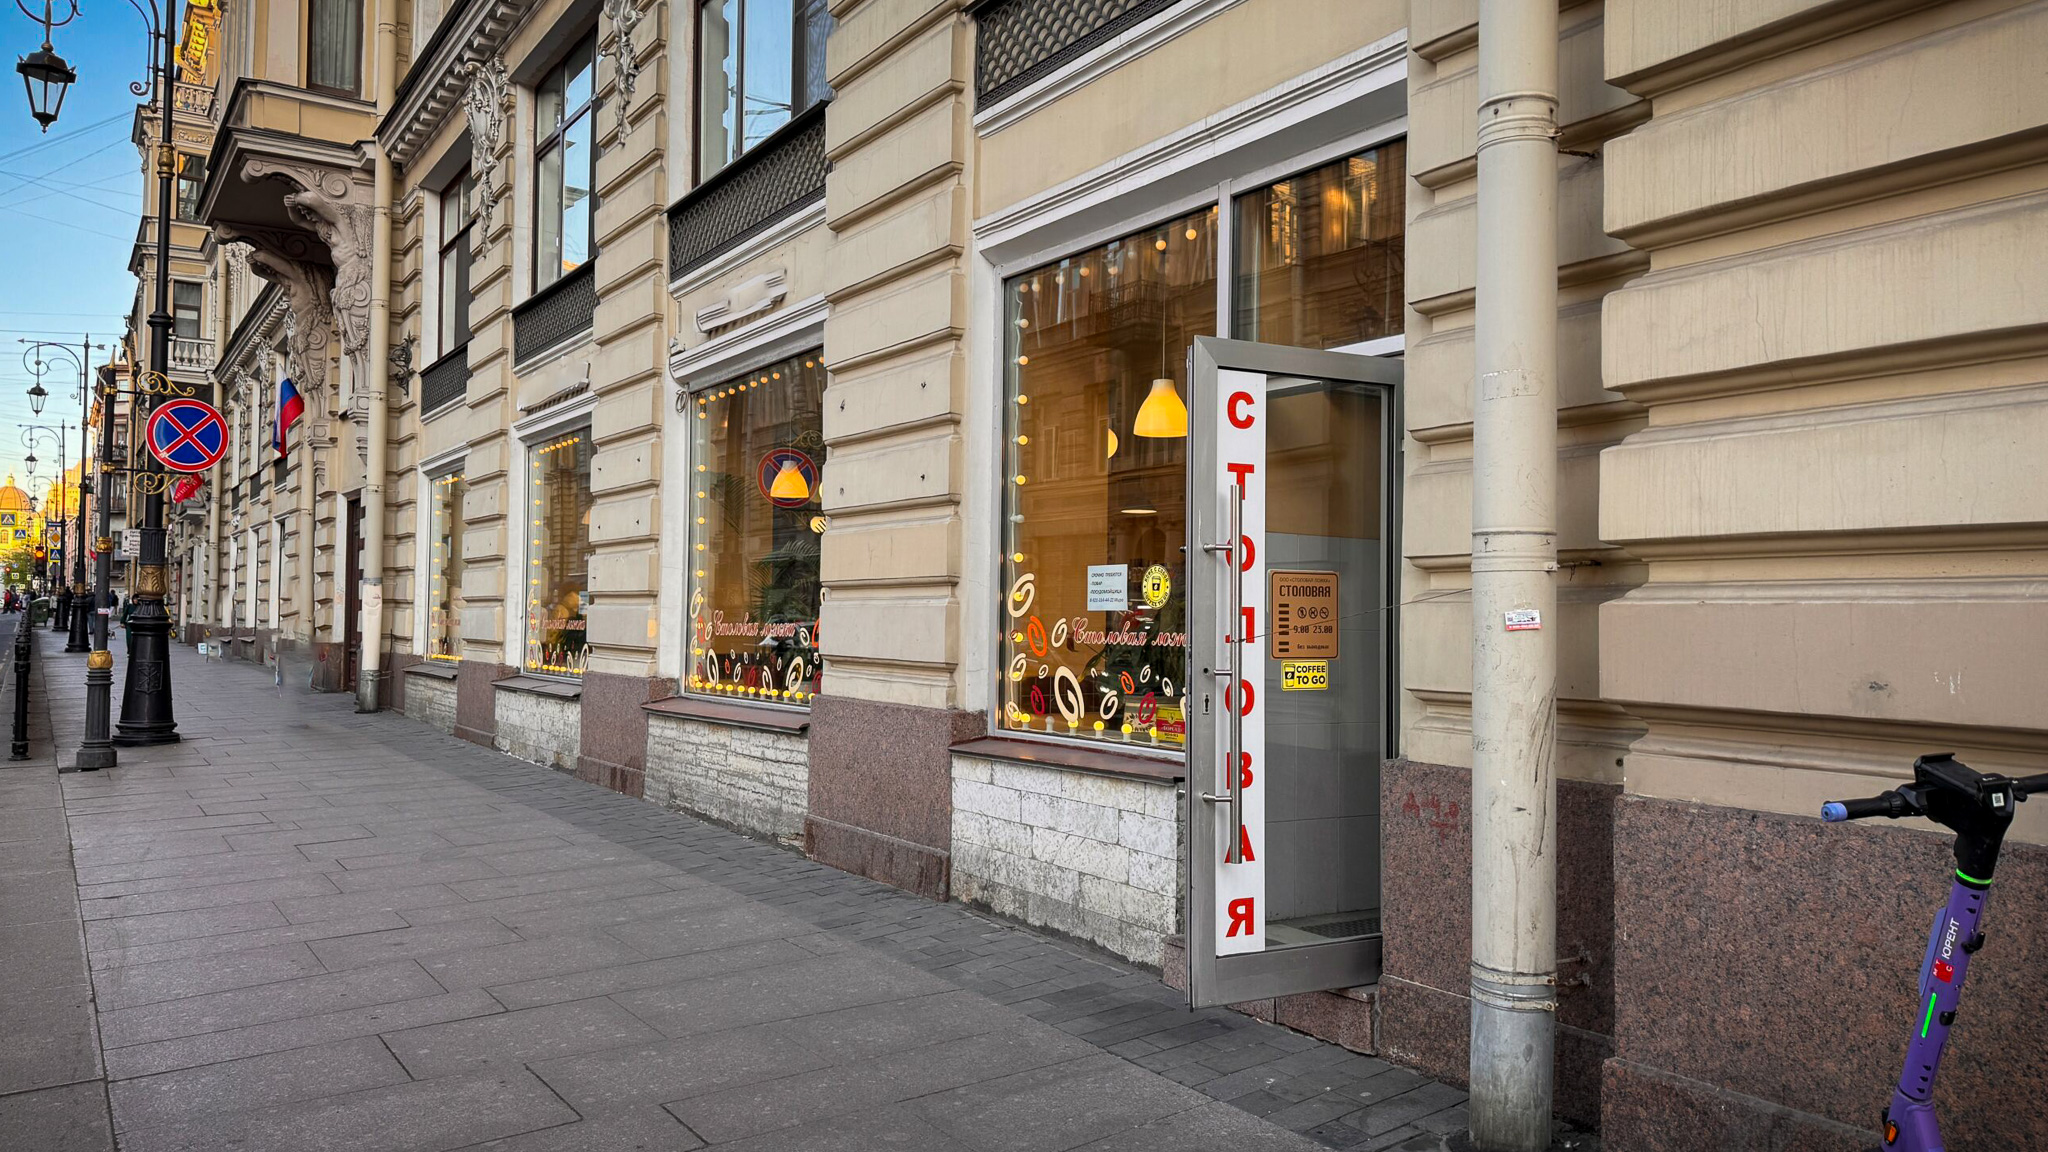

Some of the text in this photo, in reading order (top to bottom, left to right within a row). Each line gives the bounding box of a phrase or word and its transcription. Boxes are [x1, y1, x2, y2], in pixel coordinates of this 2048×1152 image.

[1279, 585, 1331, 598] СТОЛОВАЯ
[713, 609, 759, 637] Столовая
[1293, 625, 1333, 634] 9.00 23.00
[1072, 616, 1147, 646] Столовая
[1296, 665, 1326, 673] COFFEE
[1296, 675, 1326, 684] TO GO
[1941, 916, 1960, 960] ЮРЕНТ
